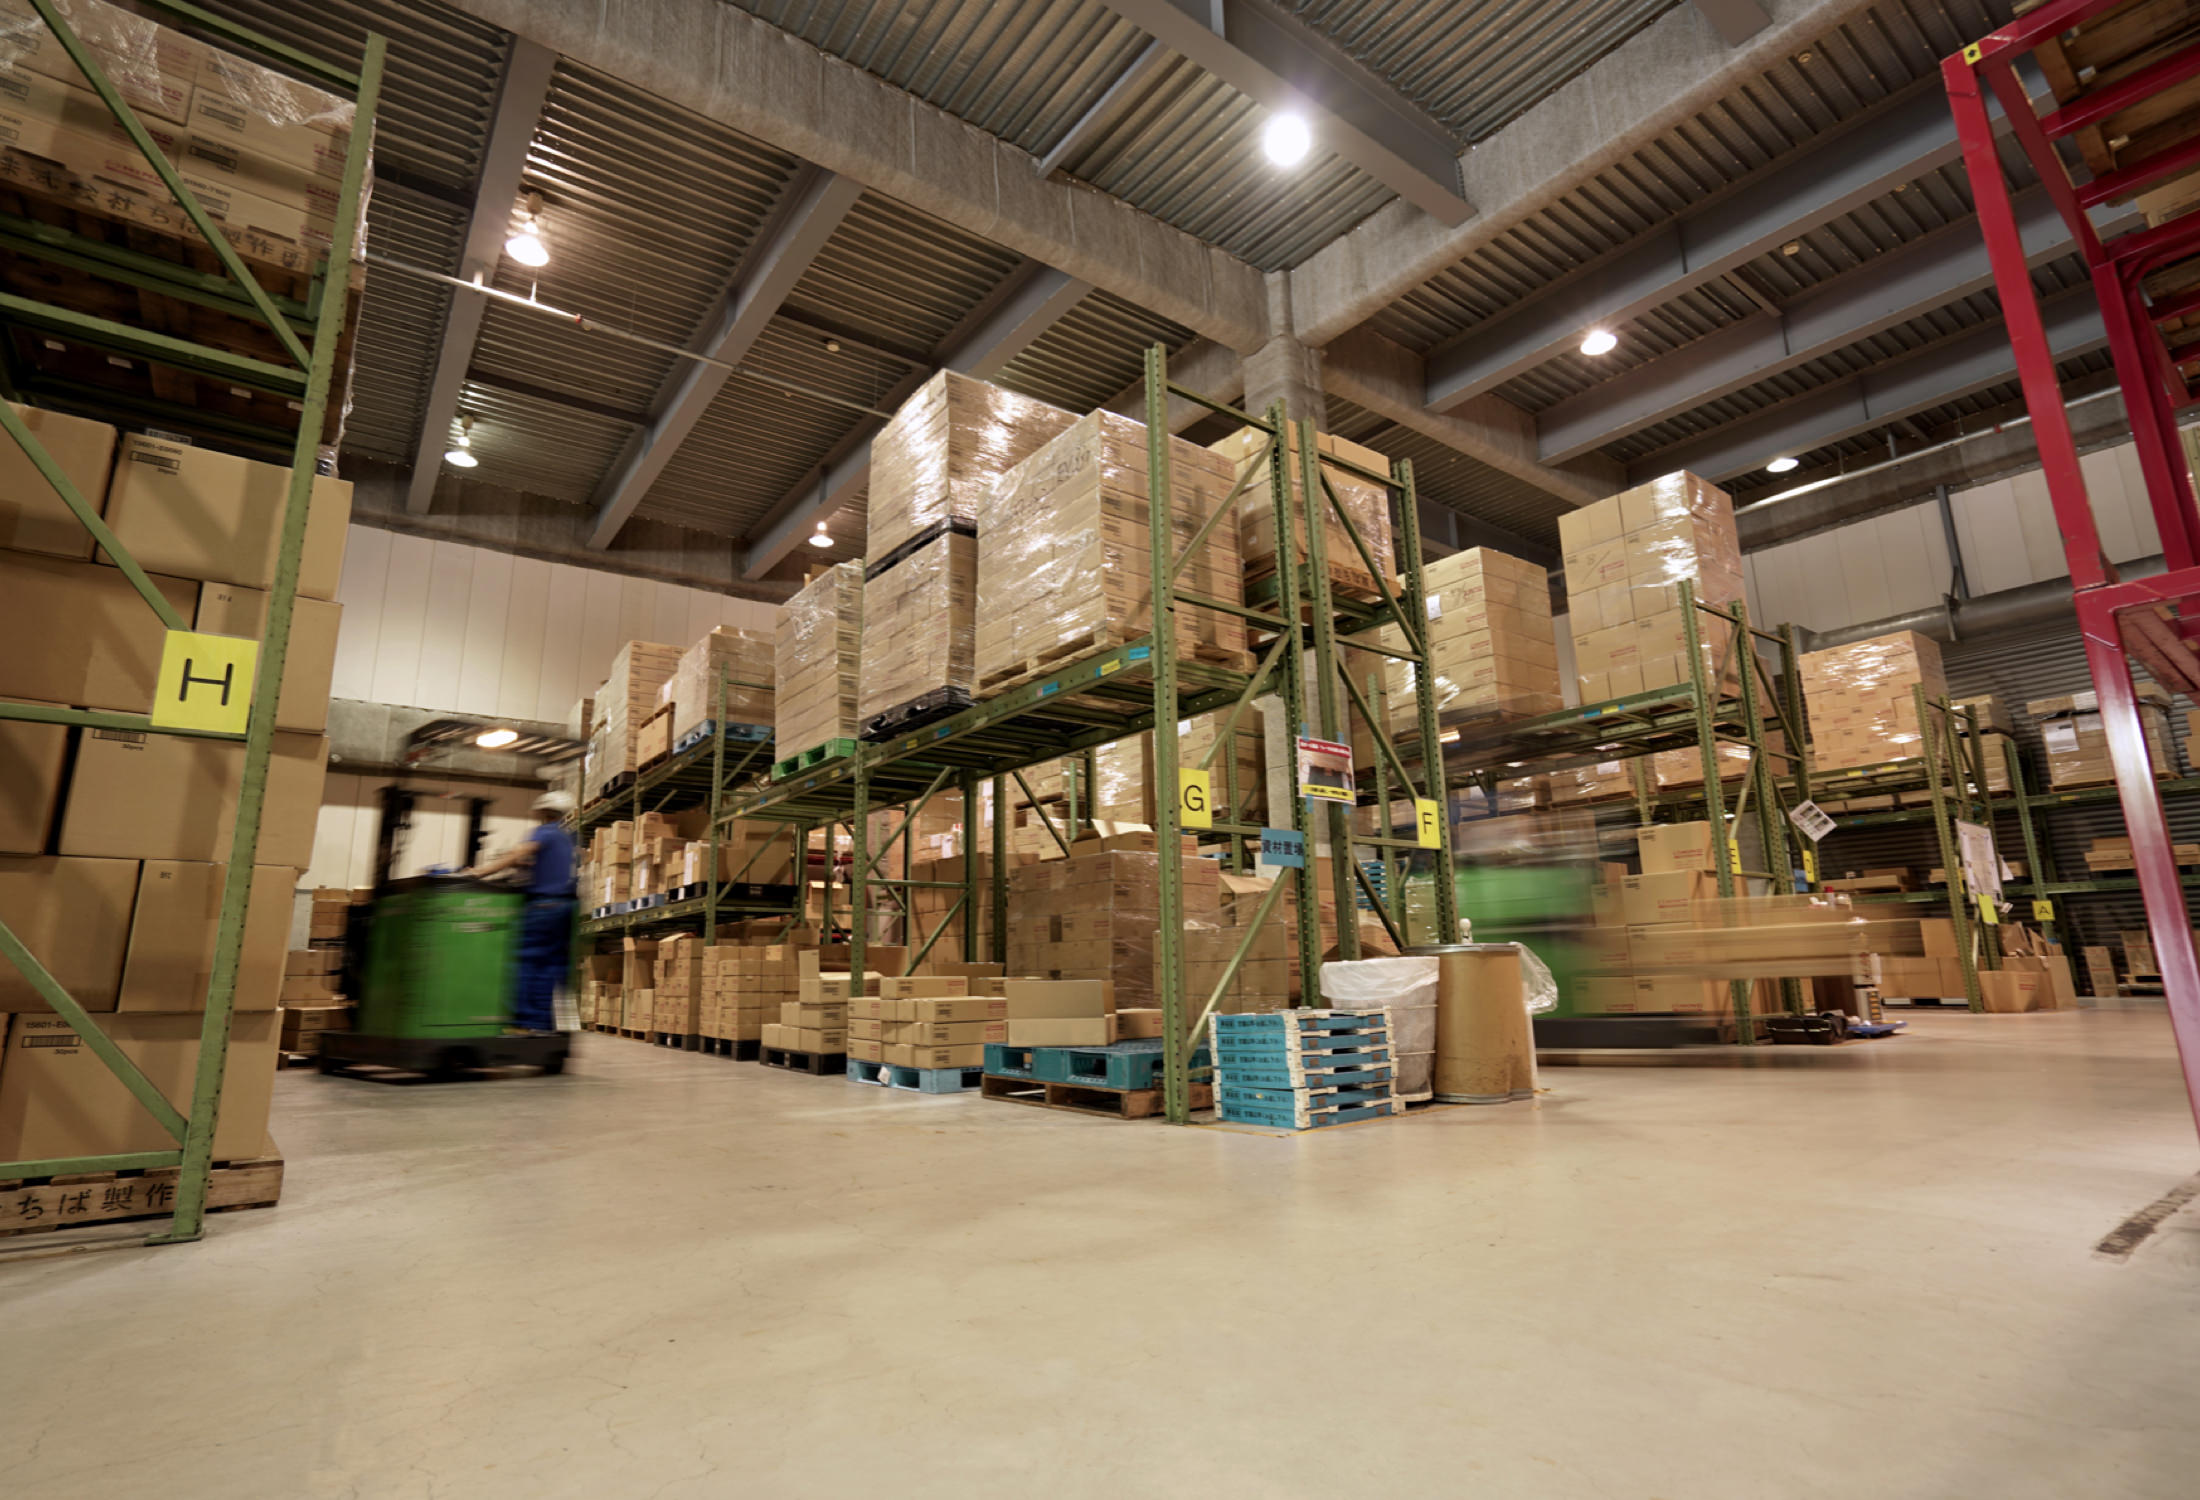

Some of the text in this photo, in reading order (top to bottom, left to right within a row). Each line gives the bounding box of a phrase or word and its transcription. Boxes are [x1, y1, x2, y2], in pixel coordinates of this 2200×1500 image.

[179, 658, 234, 706] H
[1184, 785, 1205, 812] G
[1422, 812, 1432, 834] F
[2038, 905, 2051, 915] A
[18, 1181, 213, 1220] ちば製作
